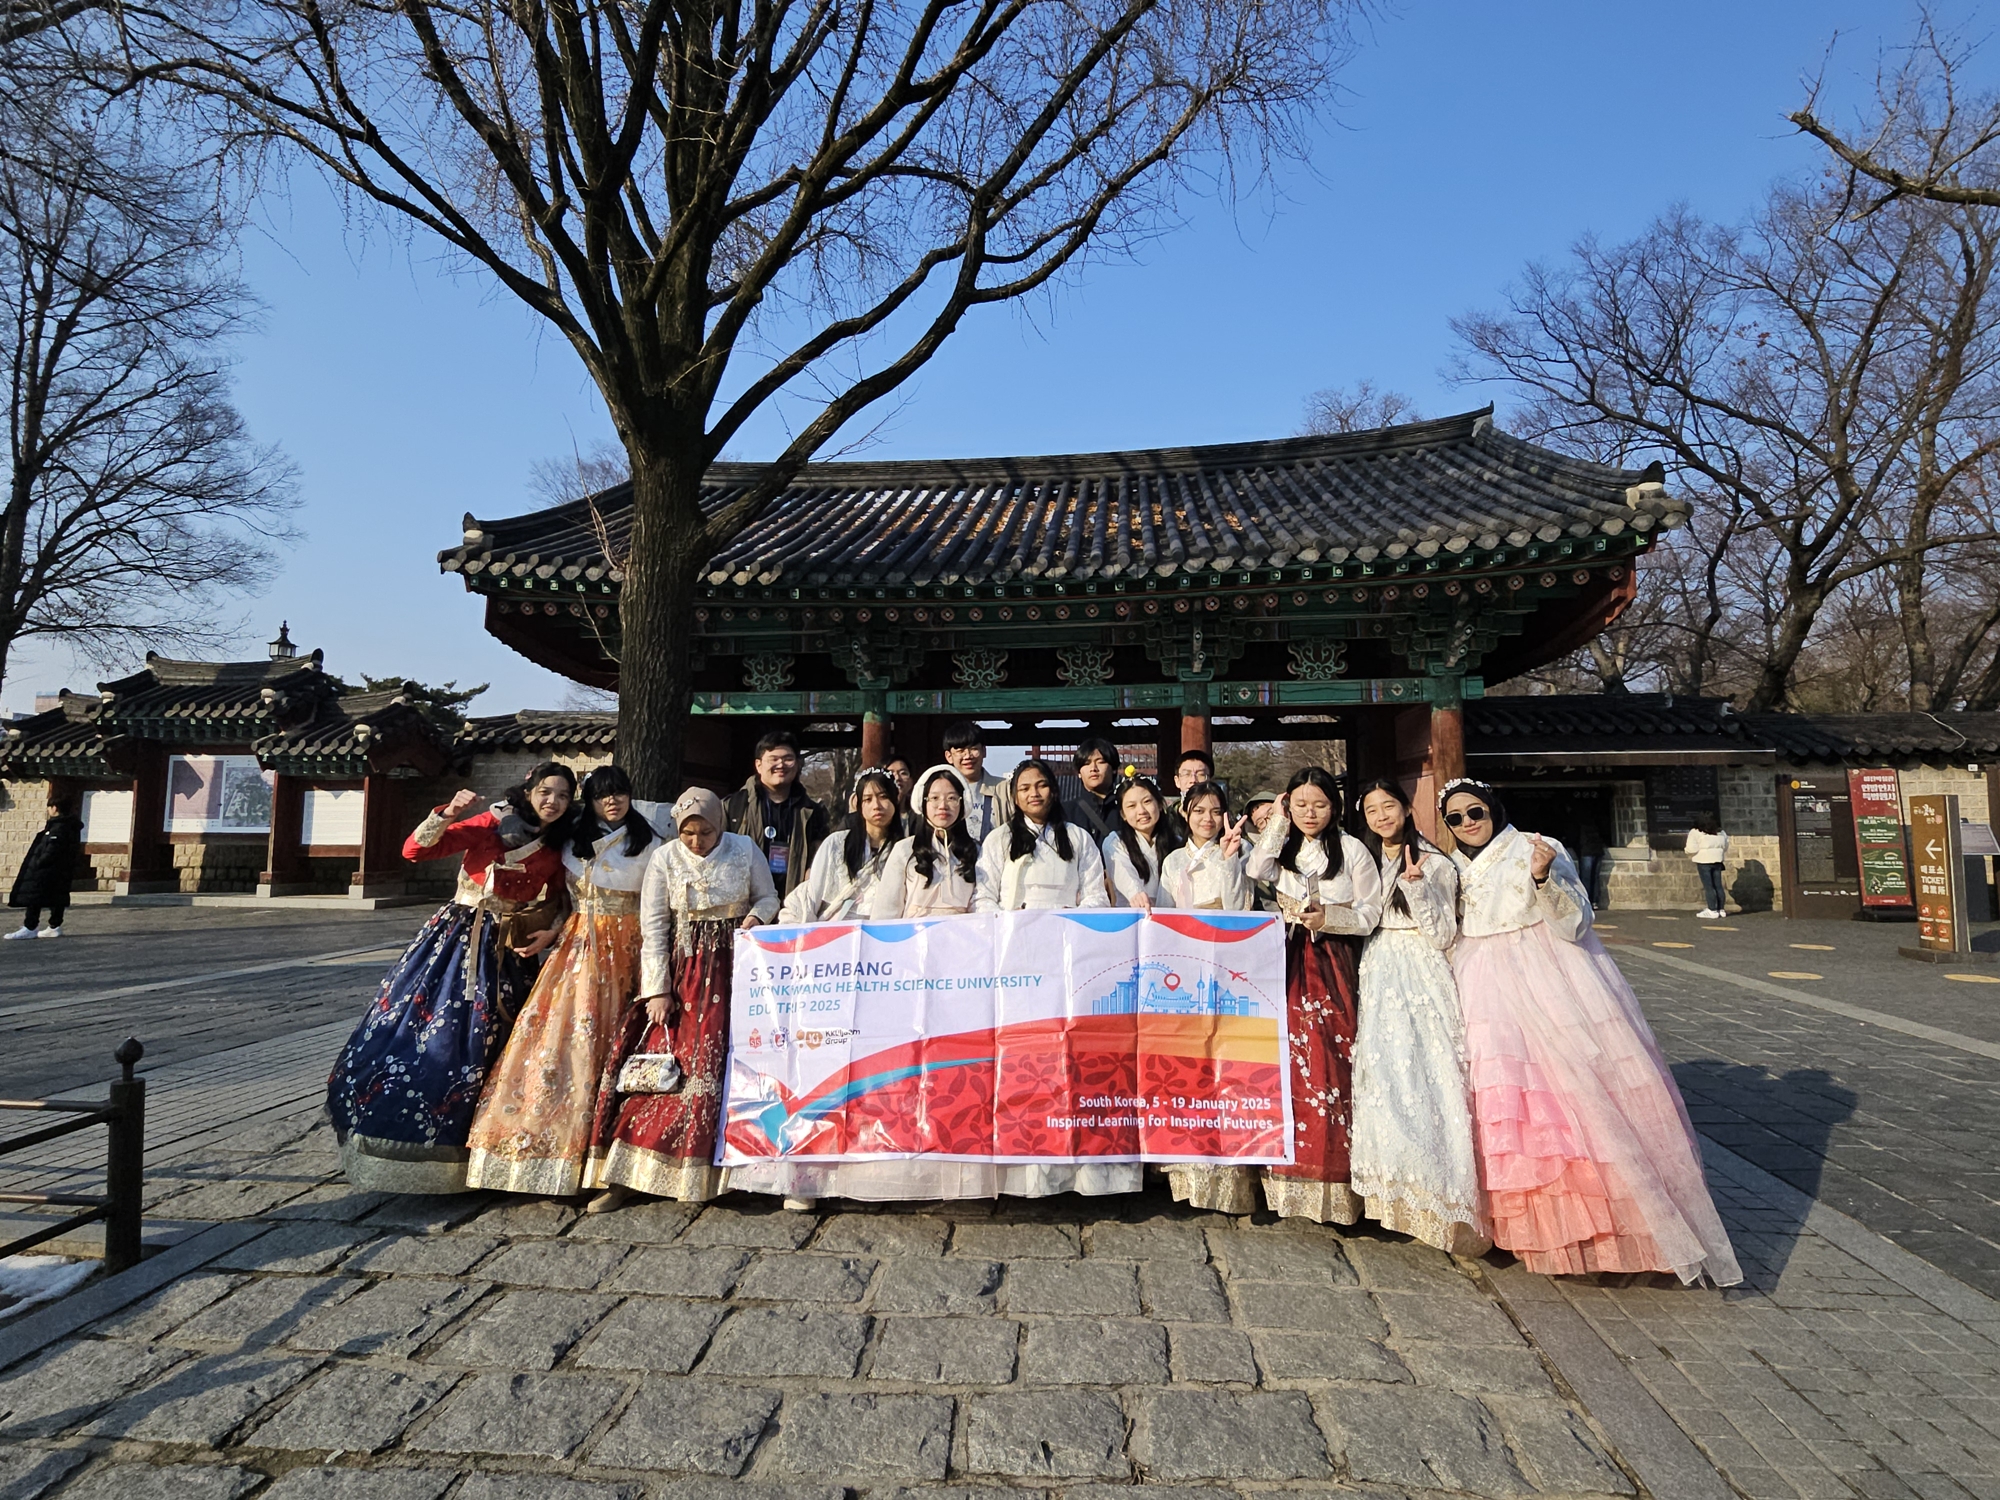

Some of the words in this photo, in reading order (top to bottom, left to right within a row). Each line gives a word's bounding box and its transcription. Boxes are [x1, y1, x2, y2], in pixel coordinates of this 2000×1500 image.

[1920, 865, 1945, 874] 매표소
[1921, 876, 1945, 885] TICKET
[749, 966, 775, 982] SS
[835, 980, 889, 993] HEALTH
[893, 978, 953, 992] SCIENCE
[957, 975, 1042, 989] UNIVERSITY
[748, 1005, 771, 1016] EDU
[777, 1001, 806, 1013] TRIP
[809, 999, 841, 1012] 2025
[750, 1039, 761, 1047] SIS
[825, 1037, 848, 1045] Group
[1079, 1096, 1111, 1107] South
[1114, 1096, 1149, 1110] Korea,
[1153, 1097, 1159, 1107] 5
[1171, 1097, 1185, 1108] 19
[1188, 1097, 1238, 1111] January
[1241, 1098, 1271, 1109] 2025
[1046, 1115, 1095, 1130] Inspired
[1098, 1115, 1144, 1128] Learning
[1148, 1115, 1168, 1126] for
[1170, 1116, 1220, 1130] Inspired
[1223, 1117, 1273, 1129] Futures
